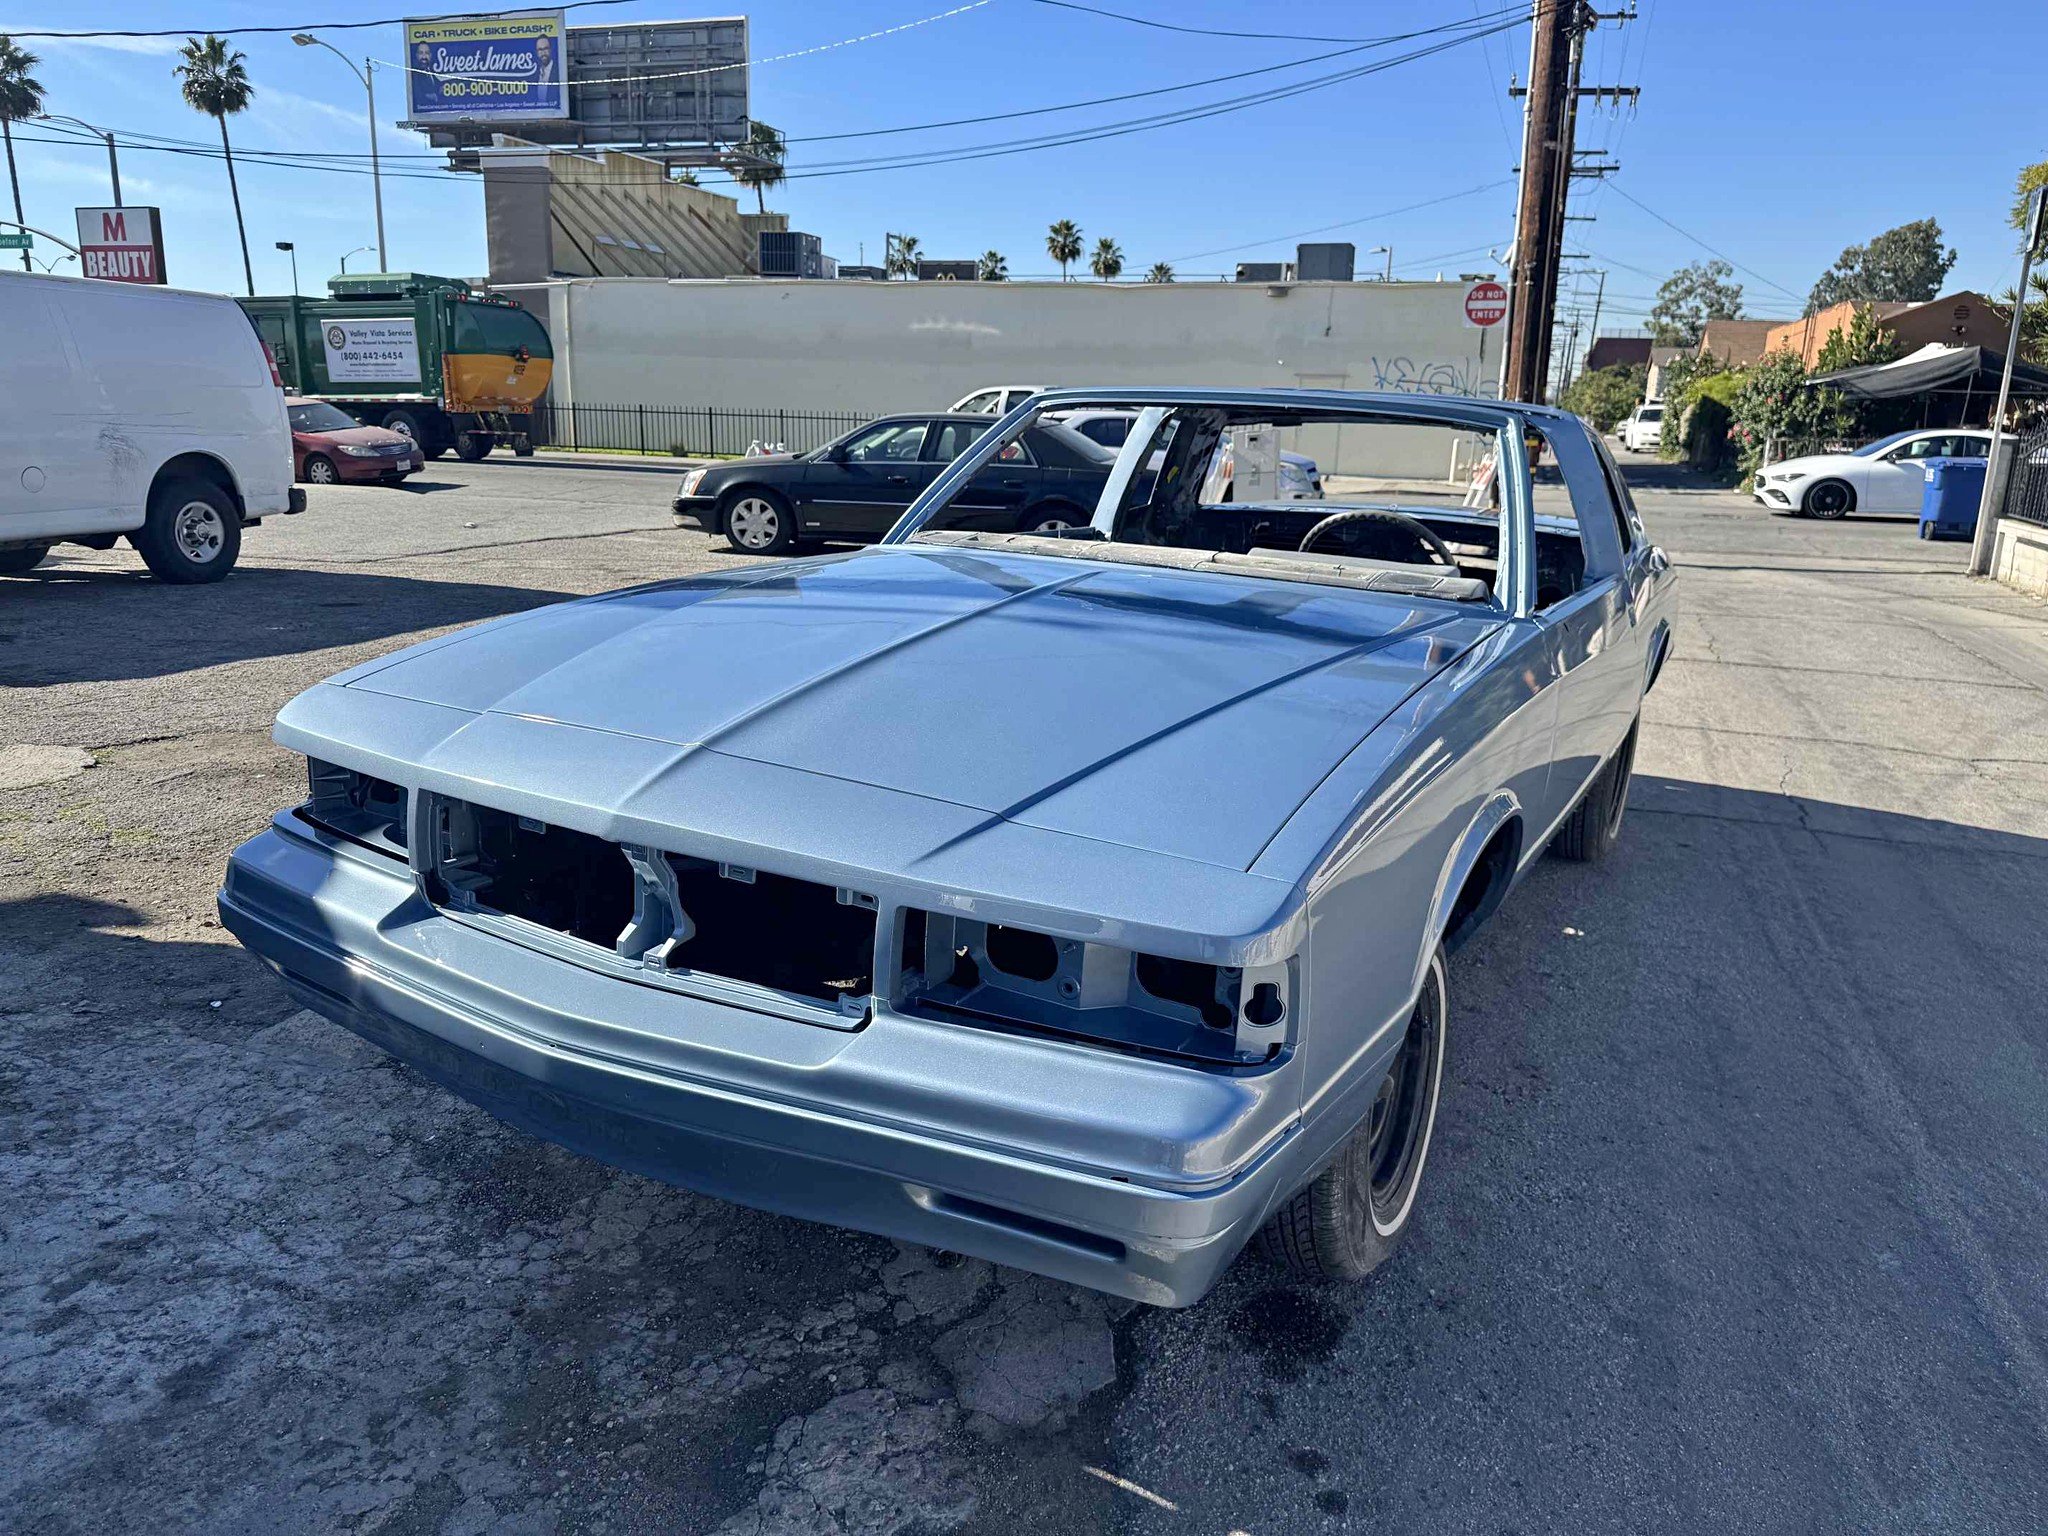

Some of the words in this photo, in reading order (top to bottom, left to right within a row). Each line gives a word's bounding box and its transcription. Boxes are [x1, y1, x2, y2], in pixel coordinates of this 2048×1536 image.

[413, 30, 436, 38] CAR
[441, 28, 477, 37] TRUCK
[484, 26, 508, 35] BIKE
[509, 24, 554, 34] CRASH?
[443, 81, 528, 97] 800-900-0000
[102, 212, 127, 242] M
[85, 251, 151, 278] BEAUTY
[1471, 290, 1484, 299] DO
[1486, 290, 1504, 299] NOT
[1471, 310, 1501, 319] ENTER
[349, 329, 368, 339] Valley
[370, 329, 386, 337] Vista
[388, 329, 413, 337] Services
